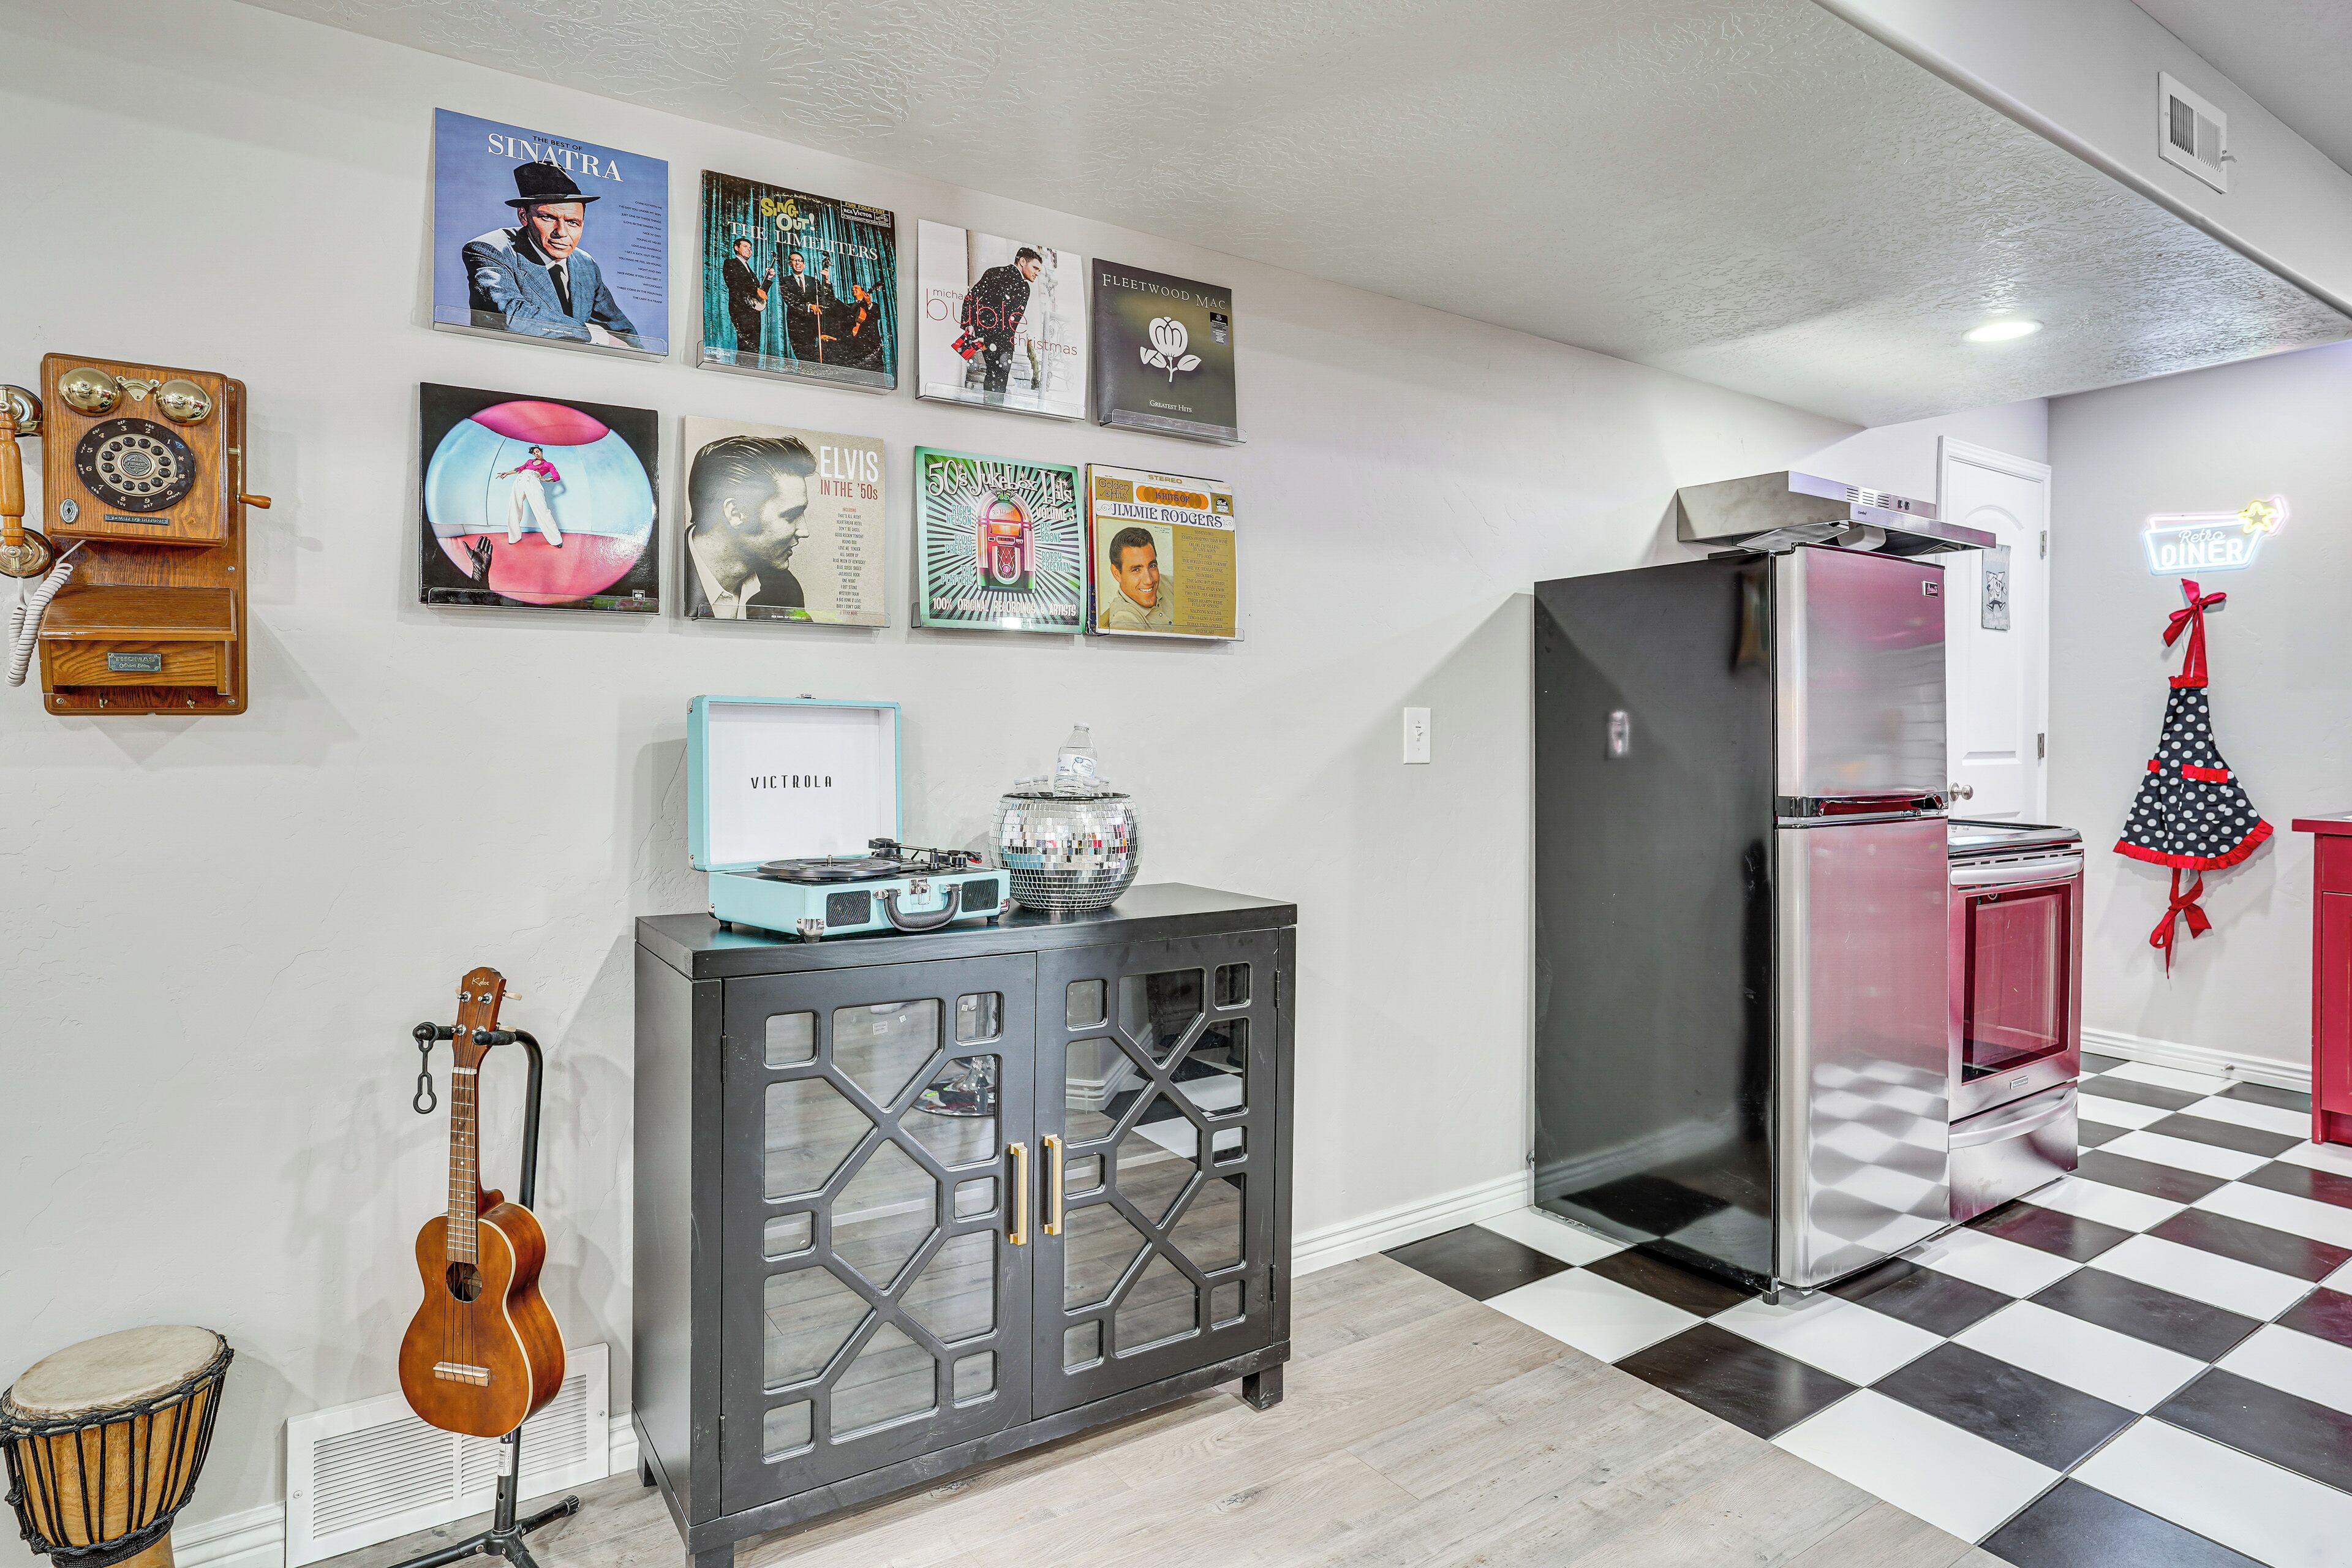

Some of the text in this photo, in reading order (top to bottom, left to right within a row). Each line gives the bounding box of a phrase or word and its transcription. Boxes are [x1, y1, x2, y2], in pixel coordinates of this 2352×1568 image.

[488, 133, 624, 182] SINATRA
[852, 209, 872, 218] VICTOR
[728, 221, 877, 260] THE LIMELITERS
[933, 289, 973, 301] michael
[1102, 273, 1225, 310] FLEETWOOD MAC
[926, 288, 1027, 334] bublé
[1009, 334, 1077, 356] christmas
[1150, 400, 1177, 410] GREATEST
[821, 446, 878, 482] ELVIS
[970, 460, 1038, 496] Jukebox
[1038, 469, 1072, 507] Hits
[1148, 474, 1182, 484] STEREO
[821, 480, 830, 495] IN
[833, 481, 853, 497] THE
[1098, 478, 1130, 494] Golden
[1100, 489, 1127, 501] Hits
[1162, 492, 1178, 502] HITS
[952, 505, 971, 515] RICKY
[1036, 506, 1074, 522] VOLUME 3
[1111, 503, 1223, 527] JIMMIE RODGERS
[946, 514, 971, 525] NELSON
[1041, 522, 1050, 532] PAT
[954, 535, 972, 545] ELVIS
[1041, 532, 1061, 543] BOONE
[2179, 529, 2226, 543] Retro
[946, 544, 973, 556] PRESLEY
[2162, 538, 2243, 567] DINER
[1042, 551, 1062, 562] BOBBY
[962, 565, 973, 575] THE
[1042, 562, 1070, 572] FREEMAN
[941, 574, 973, 586] PLATTERS
[933, 597, 952, 611] 100%
[957, 598, 989, 612] ORIGINAL
[993, 600, 1036, 614] RECORDINGS
[1049, 603, 1076, 617] ARTISTS
[751, 775, 831, 789] VICTROLA
[472, 977, 490, 986] Kalos
